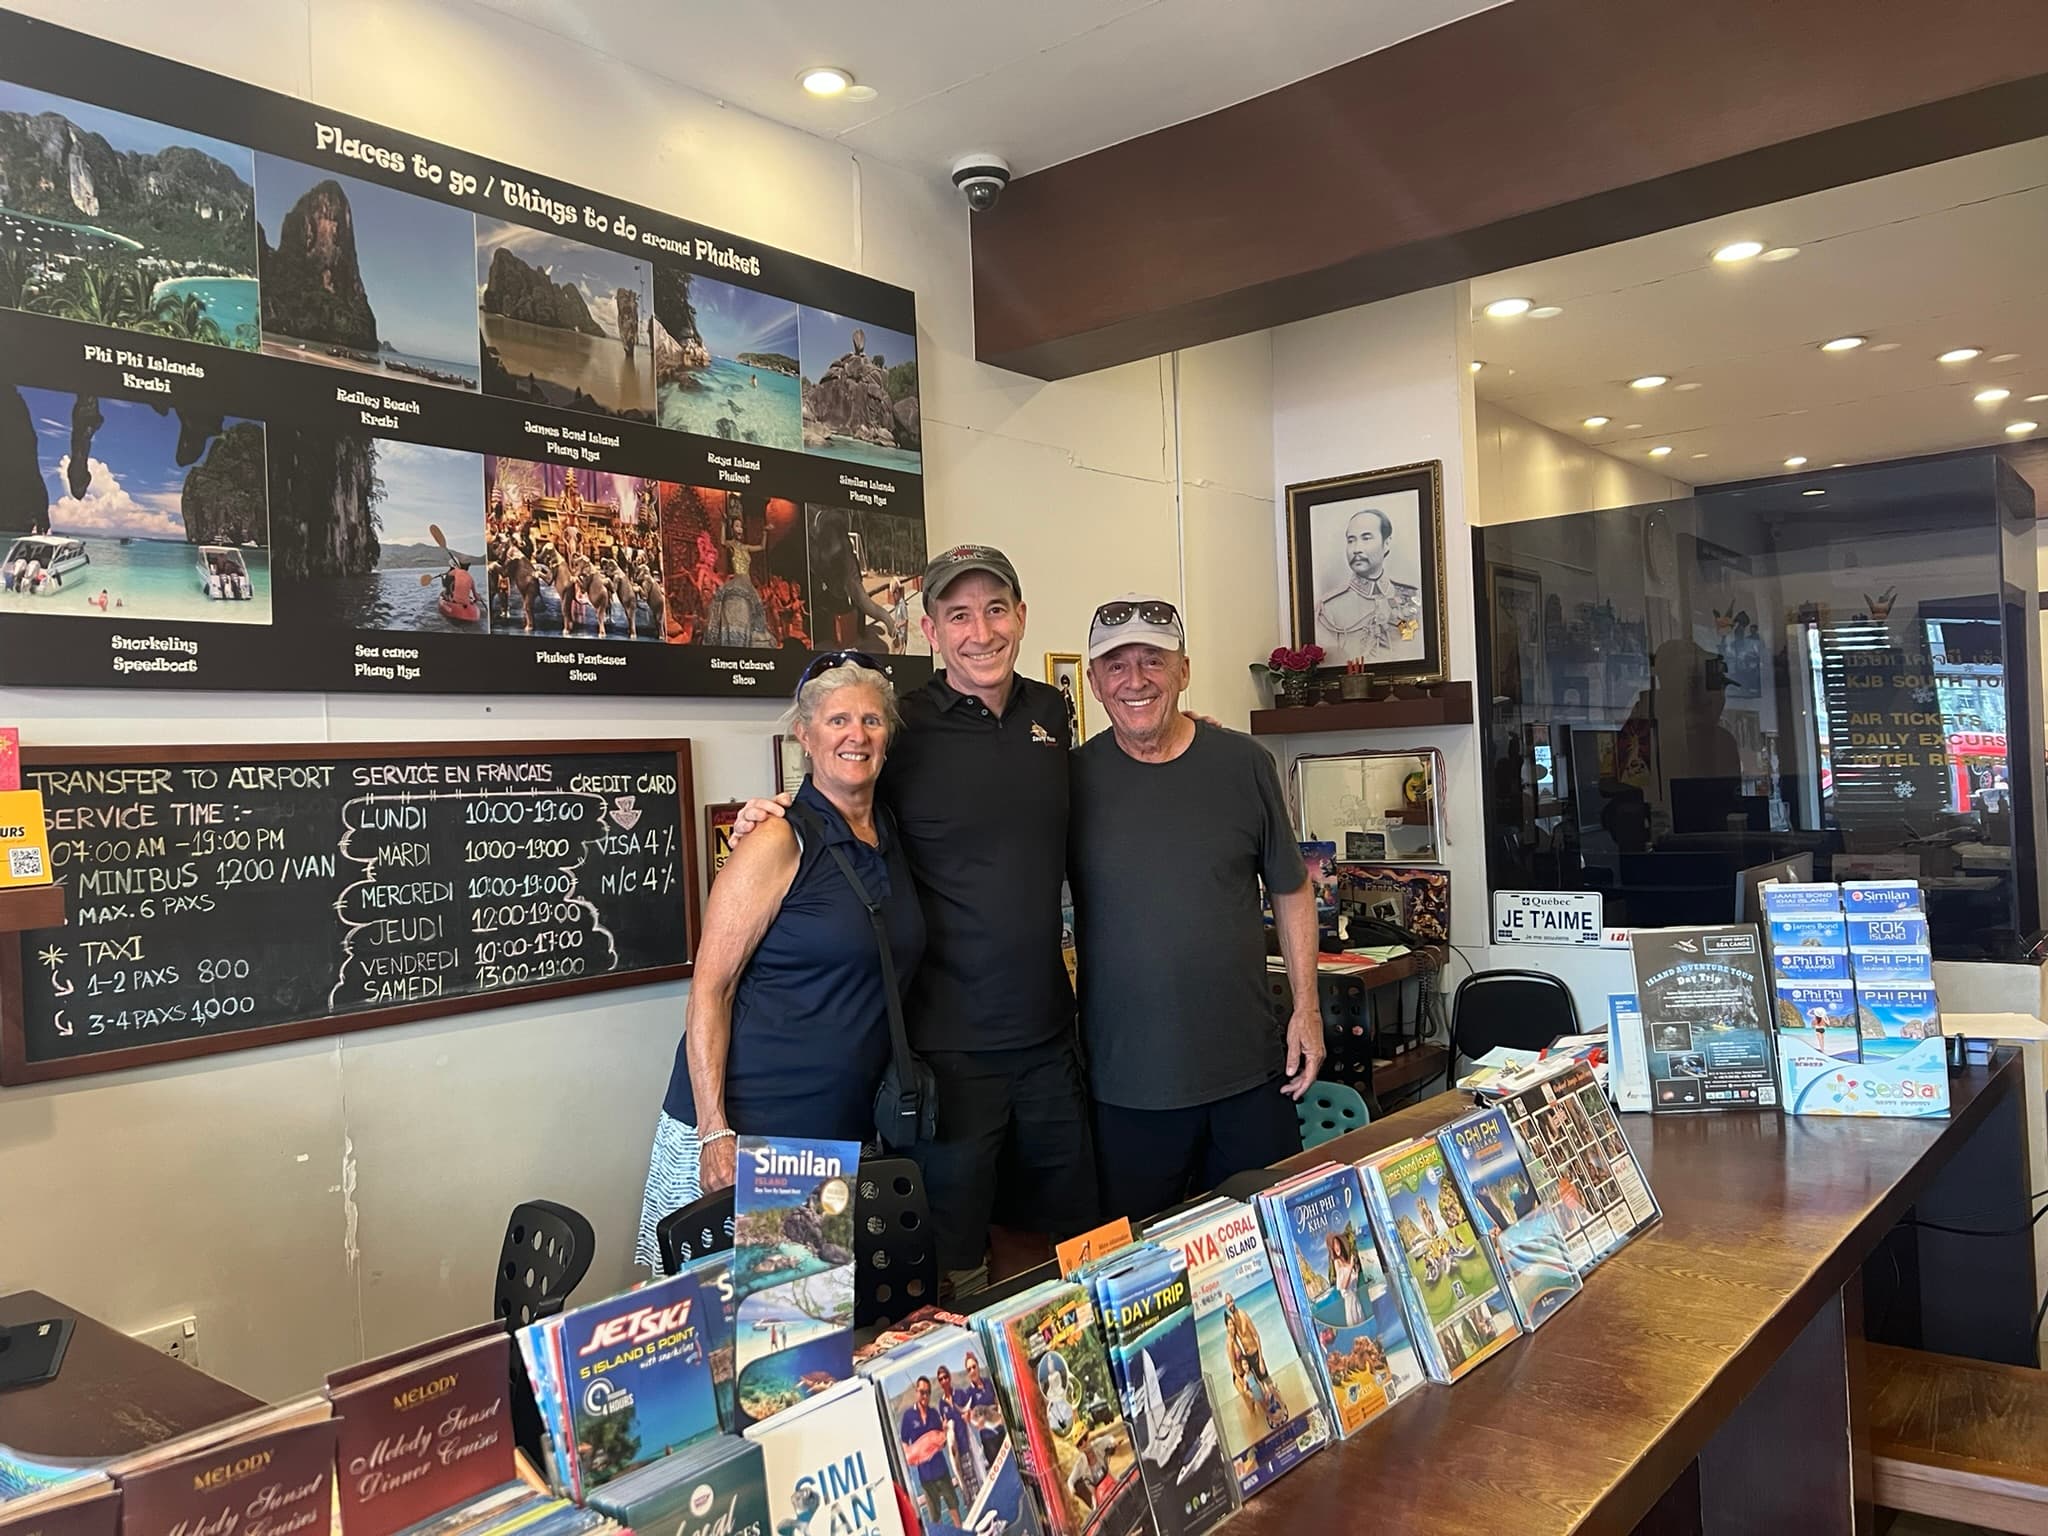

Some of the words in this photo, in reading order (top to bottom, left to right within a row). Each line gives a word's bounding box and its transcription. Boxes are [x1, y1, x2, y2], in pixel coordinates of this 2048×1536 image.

[315, 122, 405, 173] Places
[412, 154, 442, 184] to
[449, 170, 477, 196] go
[483, 176, 494, 197] /
[500, 178, 578, 224] Things
[583, 205, 607, 233] to
[612, 215, 637, 241] do
[641, 232, 690, 257] around
[694, 238, 761, 276] Phuket
[84, 346, 112, 363] Phi
[117, 351, 142, 368] Phi
[148, 356, 204, 378] Islands
[122, 373, 172, 393] Krabi
[337, 388, 379, 409] Railey
[383, 396, 420, 414] Beach
[361, 412, 399, 429] Krabi
[525, 421, 559, 436] James
[562, 427, 586, 442] Bond
[589, 431, 620, 447] Island
[546, 442, 579, 459] Phang
[581, 447, 600, 461] Nga
[708, 453, 731, 470] Raya
[734, 456, 760, 470] Island
[719, 470, 750, 484] Phuket
[840, 475, 868, 489] Similan
[850, 490, 872, 505] Phang
[112, 635, 198, 654] Snorkeling
[355, 645, 379, 658] Sea
[113, 657, 198, 673] Speedboat
[536, 652, 575, 665] Phuket
[711, 658, 737, 670] Simon
[739, 660, 775, 672] Cabaret
[355, 664, 394, 679] Phang
[397, 664, 420, 679] Nga
[569, 670, 597, 682] Show
[733, 674, 756, 685] Show
[1851, 713, 1882, 726] AIR
[1891, 713, 1981, 726] TICKETS
[1853, 733, 1910, 746] DAILY
[27, 770, 173, 795] TRANSFER
[183, 768, 217, 789] TO
[227, 766, 335, 790] AIRPORT
[353, 763, 439, 786] SERVICE
[446, 765, 469, 783] EN
[477, 763, 552, 783] FRANCAIS
[570, 774, 630, 794] CREDIT
[636, 775, 676, 794] CARD
[44, 802, 158, 830] SERVICE
[170, 802, 224, 824] TIME
[361, 807, 427, 829] LUNDI
[136, 837, 165, 859] AM
[257, 828, 285, 851] PM
[378, 842, 430, 867] MARDI
[596, 833, 641, 856] VISA
[79, 863, 199, 898] MINIBUS
[601, 866, 637, 896] M/C
[141, 900, 155, 918] 6
[163, 894, 216, 915] PAXS
[361, 881, 453, 909] MERCREDI
[1864, 891, 1910, 901] Similan
[369, 915, 443, 945] JEUDI
[1503, 910, 1523, 928] JE
[1530, 911, 1592, 930] T'AIME
[1869, 922, 1905, 933] ROK
[80, 936, 146, 966] TAXI
[360, 948, 458, 976] VENDREDI
[1793, 956, 1812, 965] Phi
[1815, 956, 1834, 965] Phi
[1862, 956, 1890, 964] PHI
[1895, 956, 1923, 964] PHI
[87, 971, 126, 996] 1-2
[134, 966, 179, 991] PAXS
[198, 959, 250, 984] 800
[364, 975, 442, 1003] SAMEDI
[1699, 974, 1722, 984] Trip
[1803, 990, 1821, 998] Phi
[1824, 990, 1842, 998] Phi
[1865, 992, 1893, 1000] PHI
[1898, 992, 1926, 1000] PHI
[88, 1011, 131, 1035] 3-4
[134, 1005, 187, 1029] PAXS
[1464, 1127, 1482, 1145] PHI
[1480, 1118, 1500, 1139] PHI
[755, 1147, 841, 1177] Similan
[1320, 1195, 1335, 1213] PHI
[1185, 1233, 1220, 1270] AYA
[1217, 1216, 1255, 1242] CORAL
[1225, 1236, 1257, 1260] ISLAND
[1121, 1296, 1150, 1326] DAY
[1153, 1282, 1184, 1310] TRIP
[593, 1346, 643, 1374] ISLAND
[646, 1342, 656, 1354] 6
[658, 1327, 695, 1350] POINT
[391, 1373, 458, 1409] MELODY
[609, 1393, 634, 1414] HOURS
[350, 1426, 433, 1475] Melody
[438, 1398, 501, 1437] Sunset
[193, 1448, 275, 1490] MELODY
[359, 1461, 432, 1502] Dinner
[438, 1430, 499, 1465] Cruises
